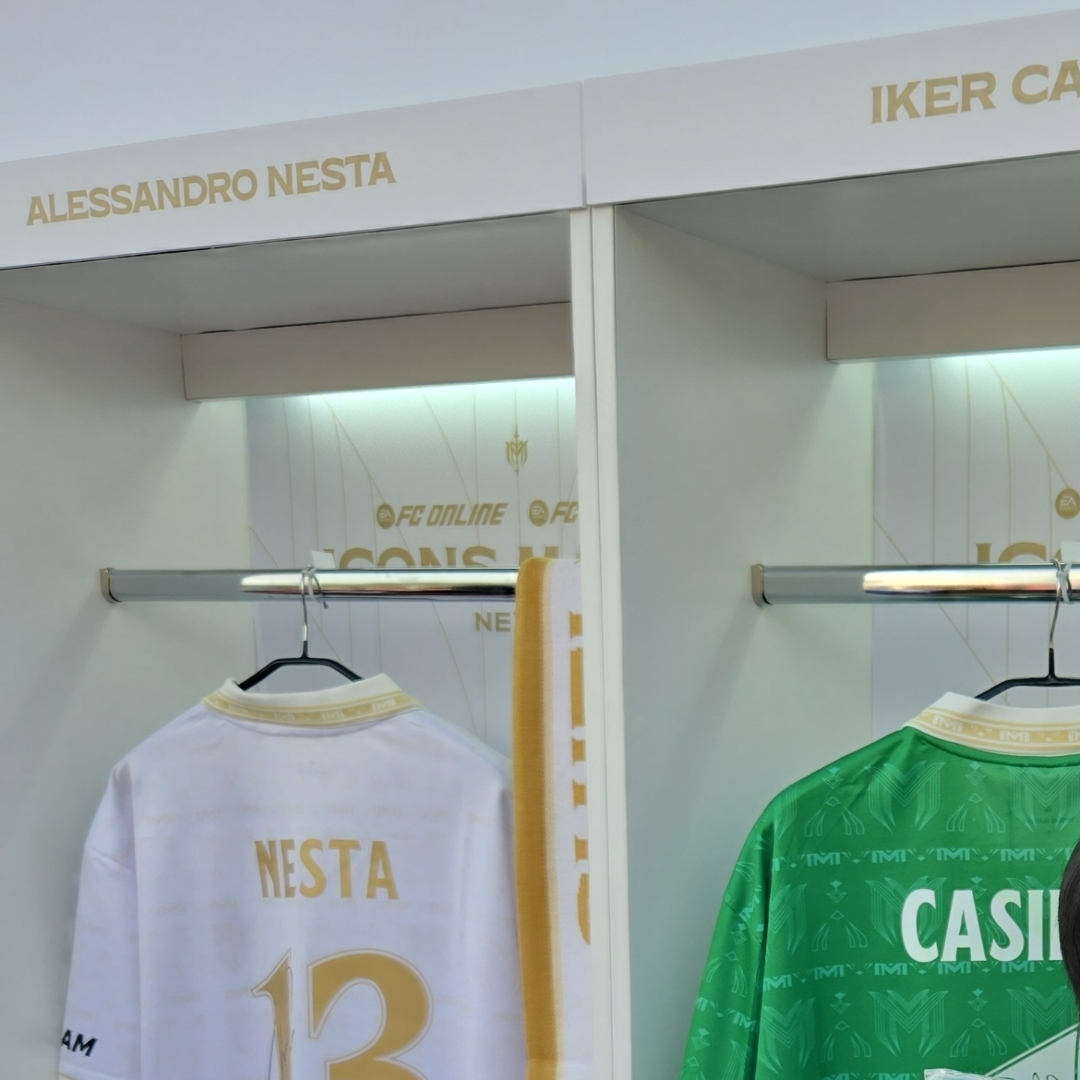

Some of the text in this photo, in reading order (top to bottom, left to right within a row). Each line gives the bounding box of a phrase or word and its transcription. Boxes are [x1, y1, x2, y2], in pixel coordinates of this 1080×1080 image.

[871, 71, 997, 124] IKER
[26, 151, 397, 226] ALESSANDRO NESTA
[395, 502, 509, 527] FC ONLINE
[254, 838, 399, 900] NESTA
